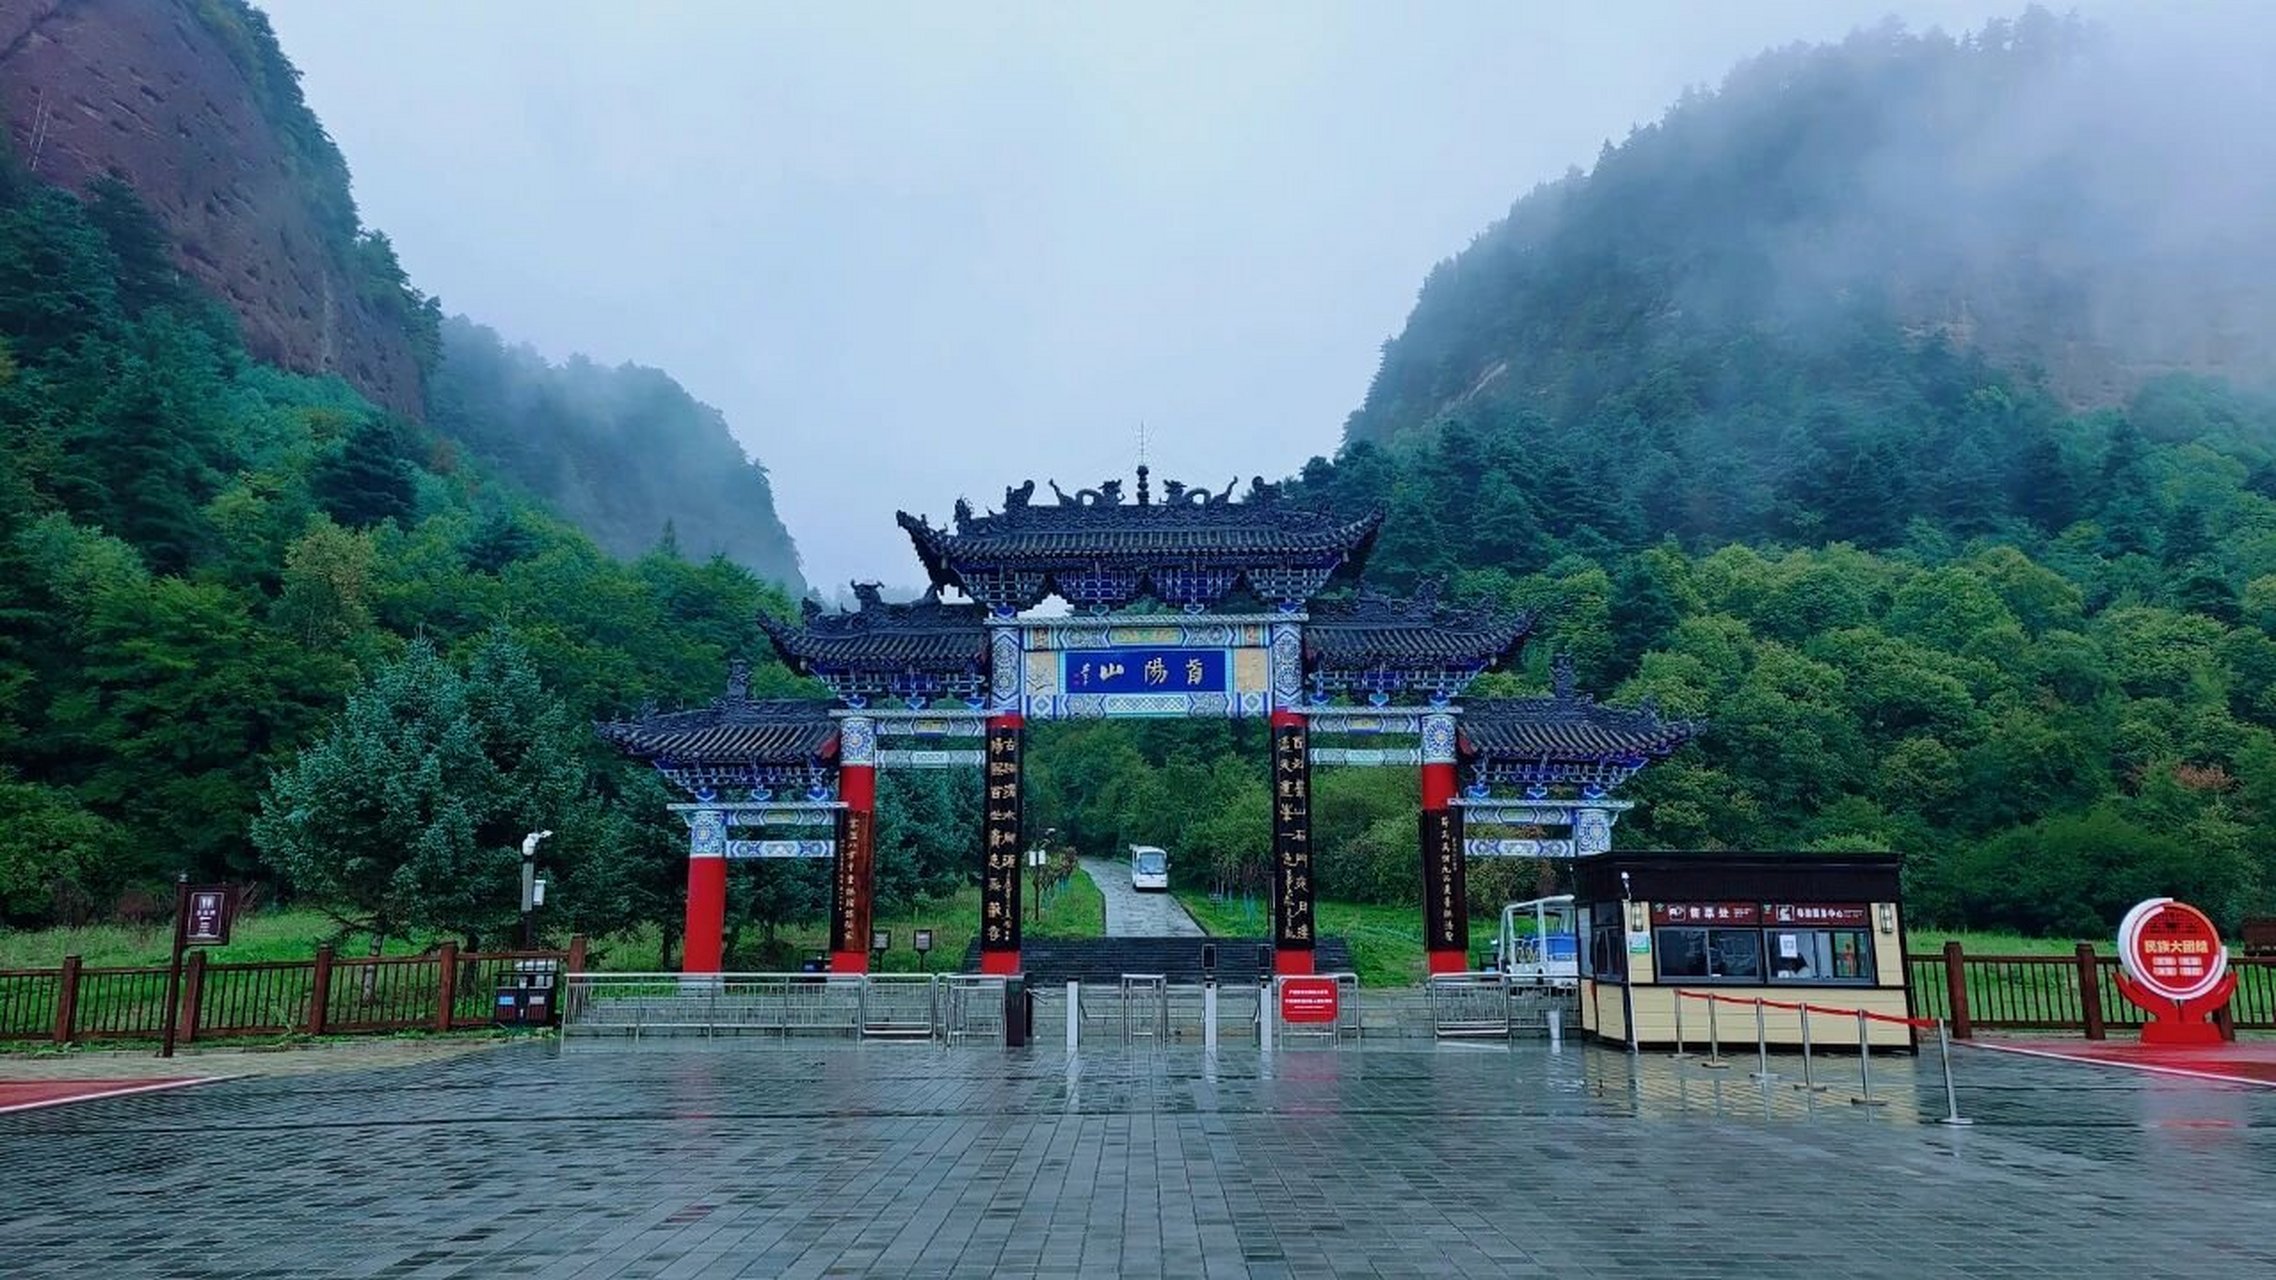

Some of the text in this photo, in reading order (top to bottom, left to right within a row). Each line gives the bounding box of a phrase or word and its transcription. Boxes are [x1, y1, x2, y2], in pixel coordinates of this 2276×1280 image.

[2144, 939, 2209, 954] 民族大团结
